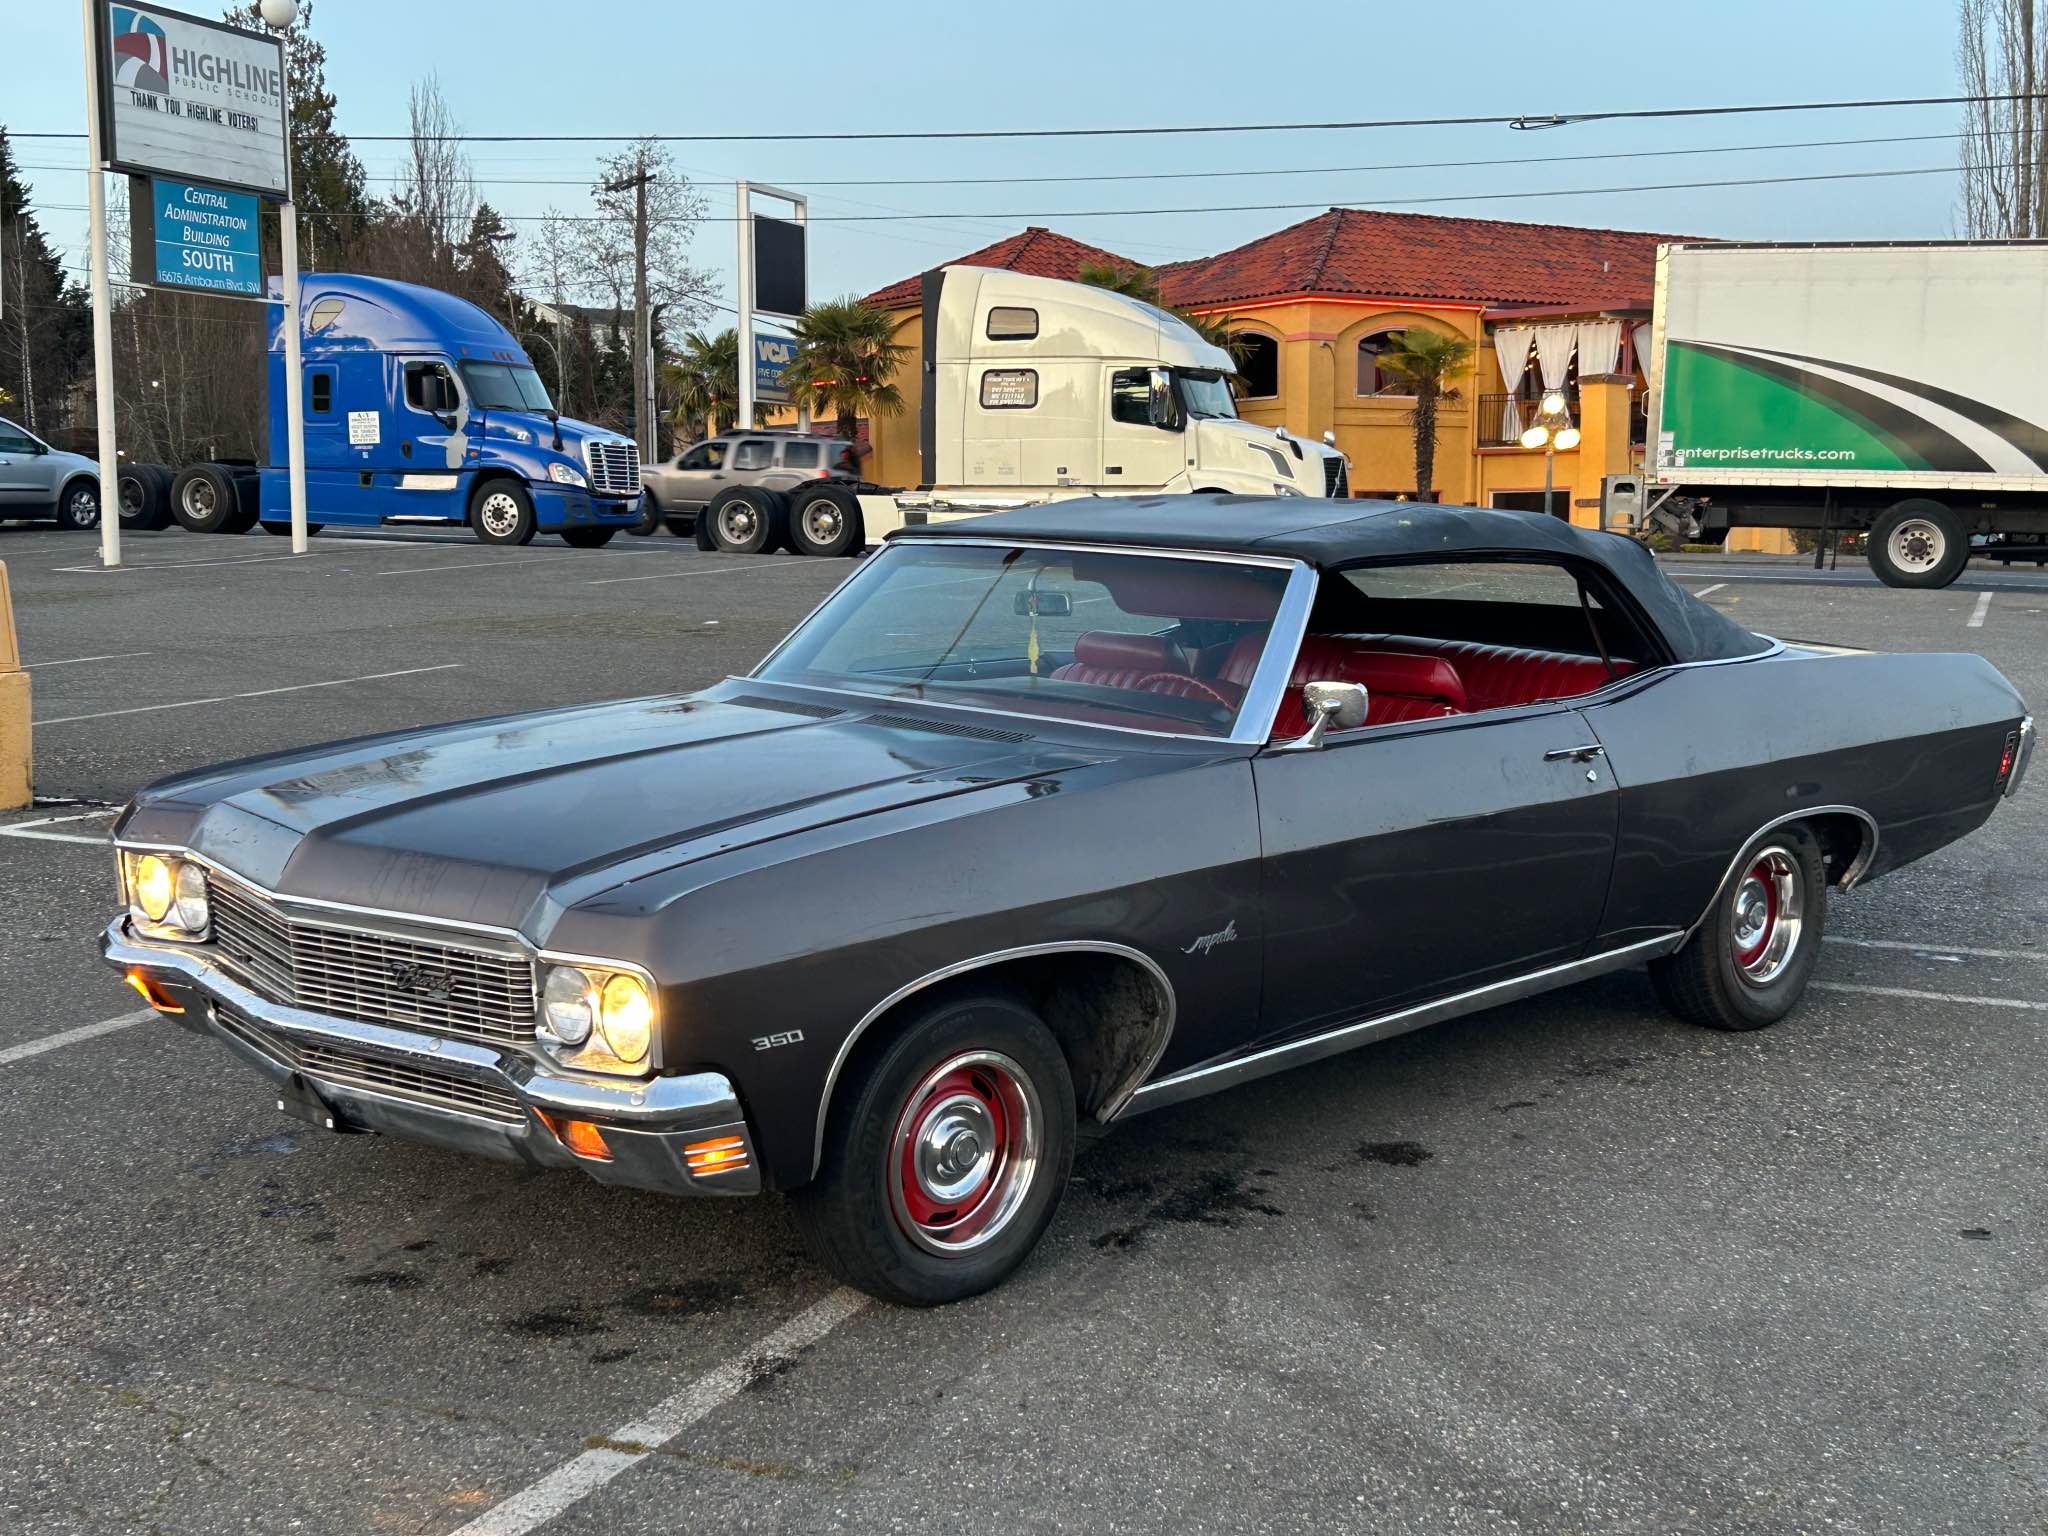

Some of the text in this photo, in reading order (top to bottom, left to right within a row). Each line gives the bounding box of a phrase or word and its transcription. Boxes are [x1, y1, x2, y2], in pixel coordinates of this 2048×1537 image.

[172, 46, 280, 97] HIGHLINE
[175, 76, 279, 107] PUBLIC SCHOOLS
[130, 90, 258, 132] THANK YOU HIGHLINE VOTERS!
[182, 250, 234, 272] SOUTH
[158, 270, 182, 284] 15675
[757, 340, 790, 364] VCA
[1675, 446, 1856, 461] enterprisetrucks.com
[752, 1029, 804, 1050] 350
